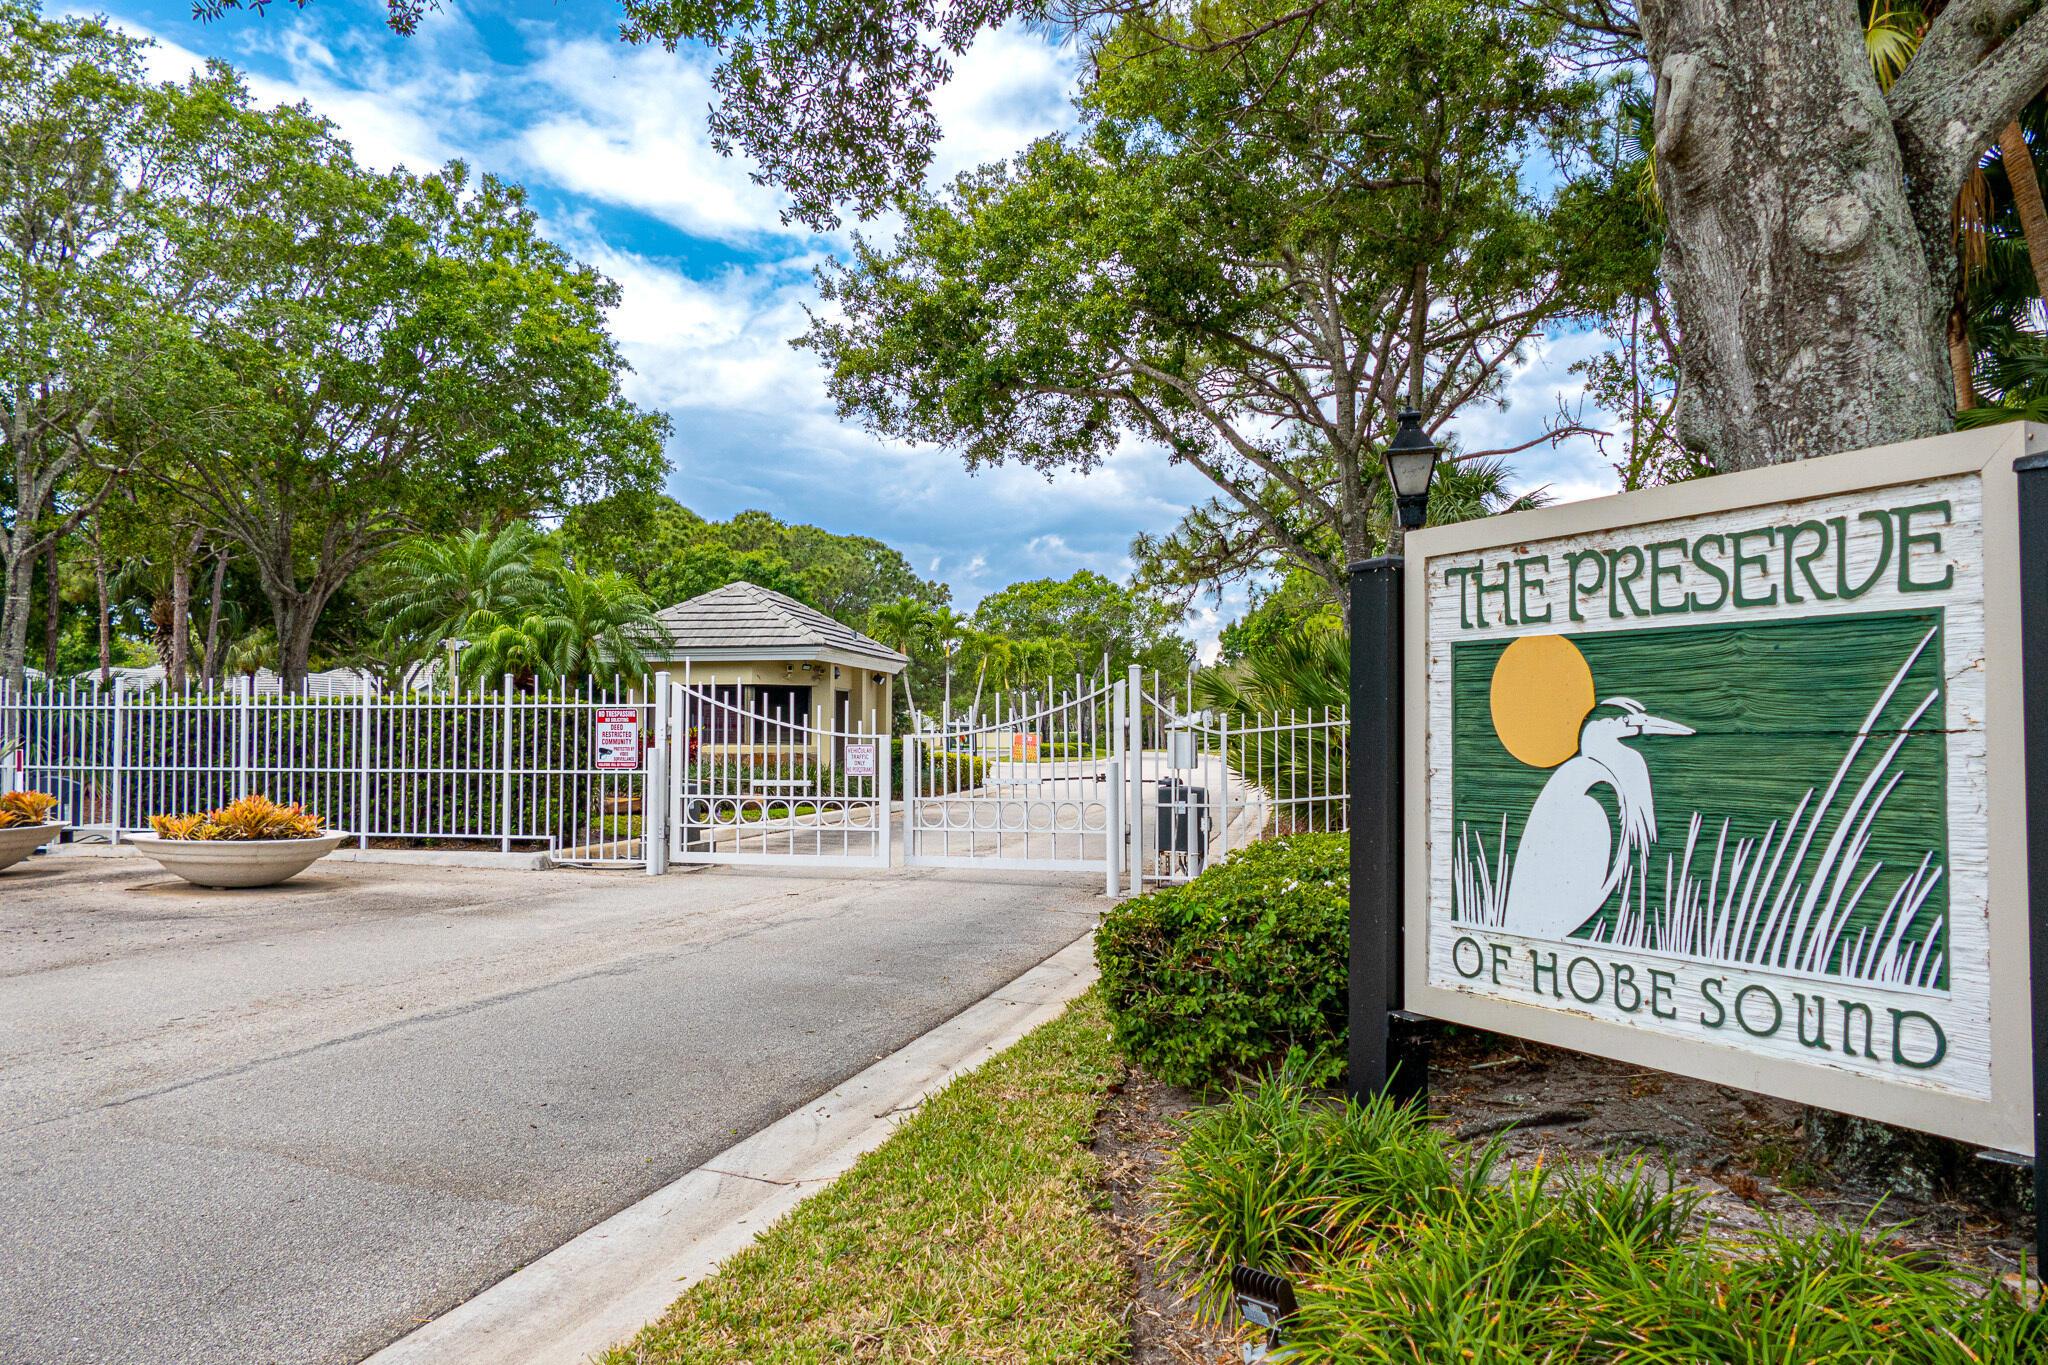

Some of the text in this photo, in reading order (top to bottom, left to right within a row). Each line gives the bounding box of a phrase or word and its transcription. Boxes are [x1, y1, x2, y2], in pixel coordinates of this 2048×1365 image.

[1444, 499, 1955, 629] THE PRESERVE
[1452, 935, 1948, 1070] OF HOBE SOUND
